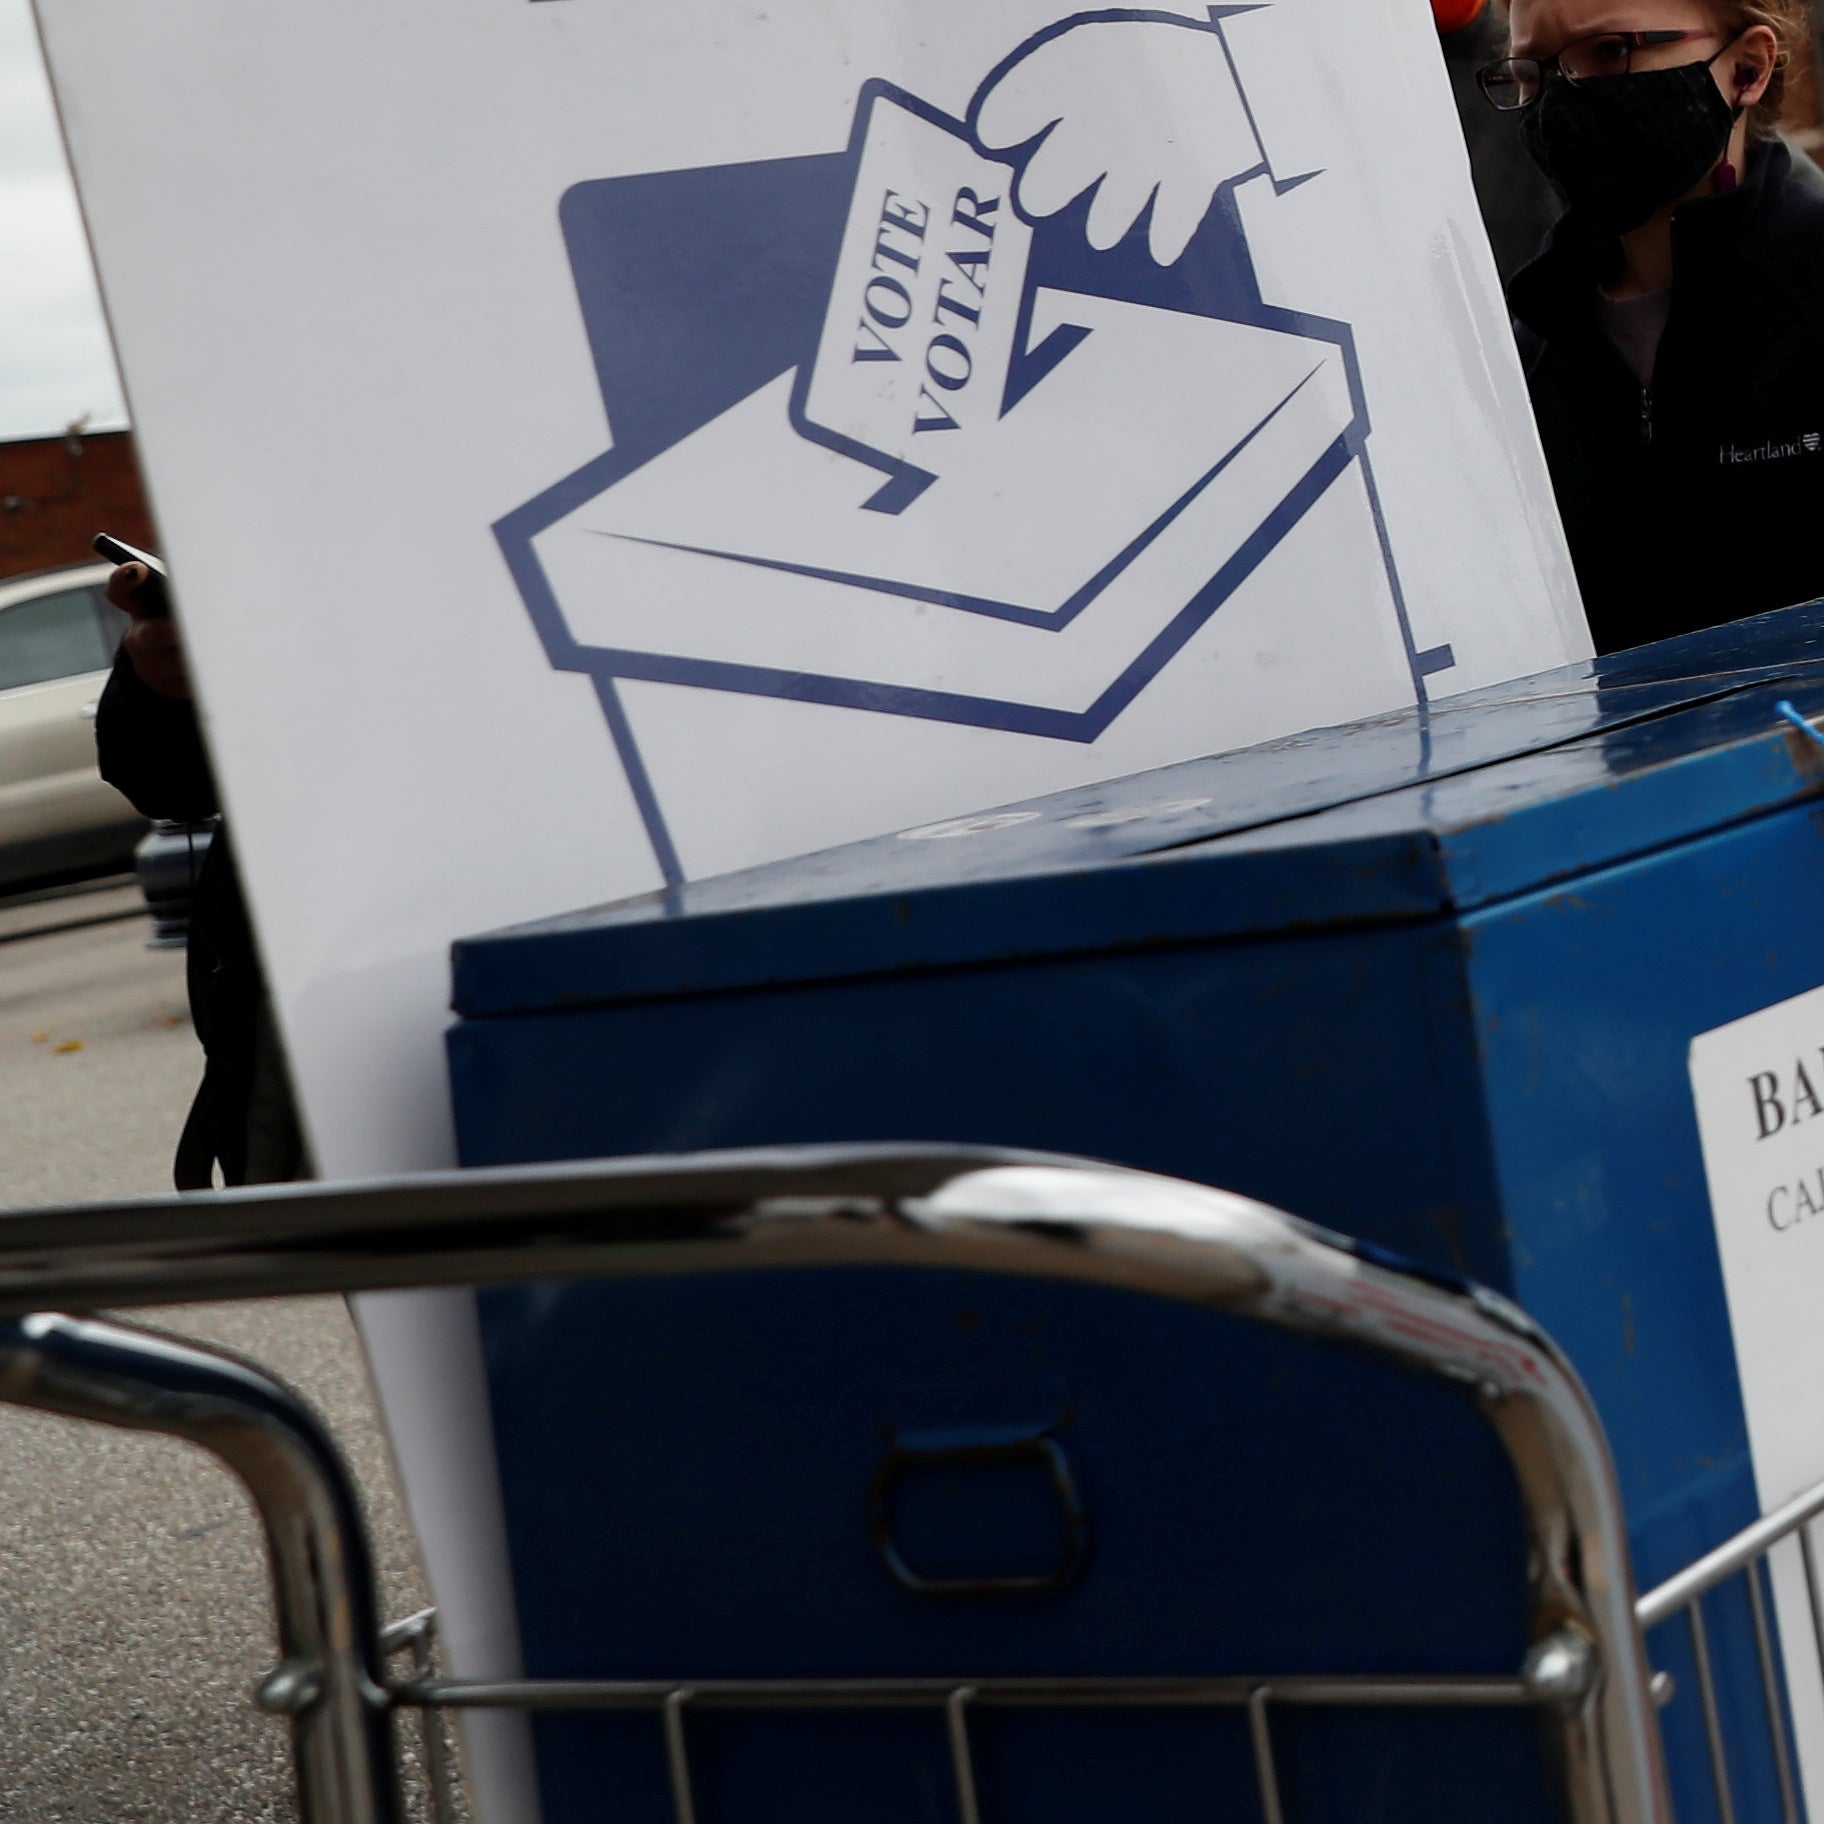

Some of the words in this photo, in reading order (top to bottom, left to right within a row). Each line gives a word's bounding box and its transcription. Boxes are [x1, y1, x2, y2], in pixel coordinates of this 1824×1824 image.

[850, 189, 931, 366] VOTE
[911, 182, 1002, 438] VOTAR
[1719, 436, 1801, 464] Heartland
